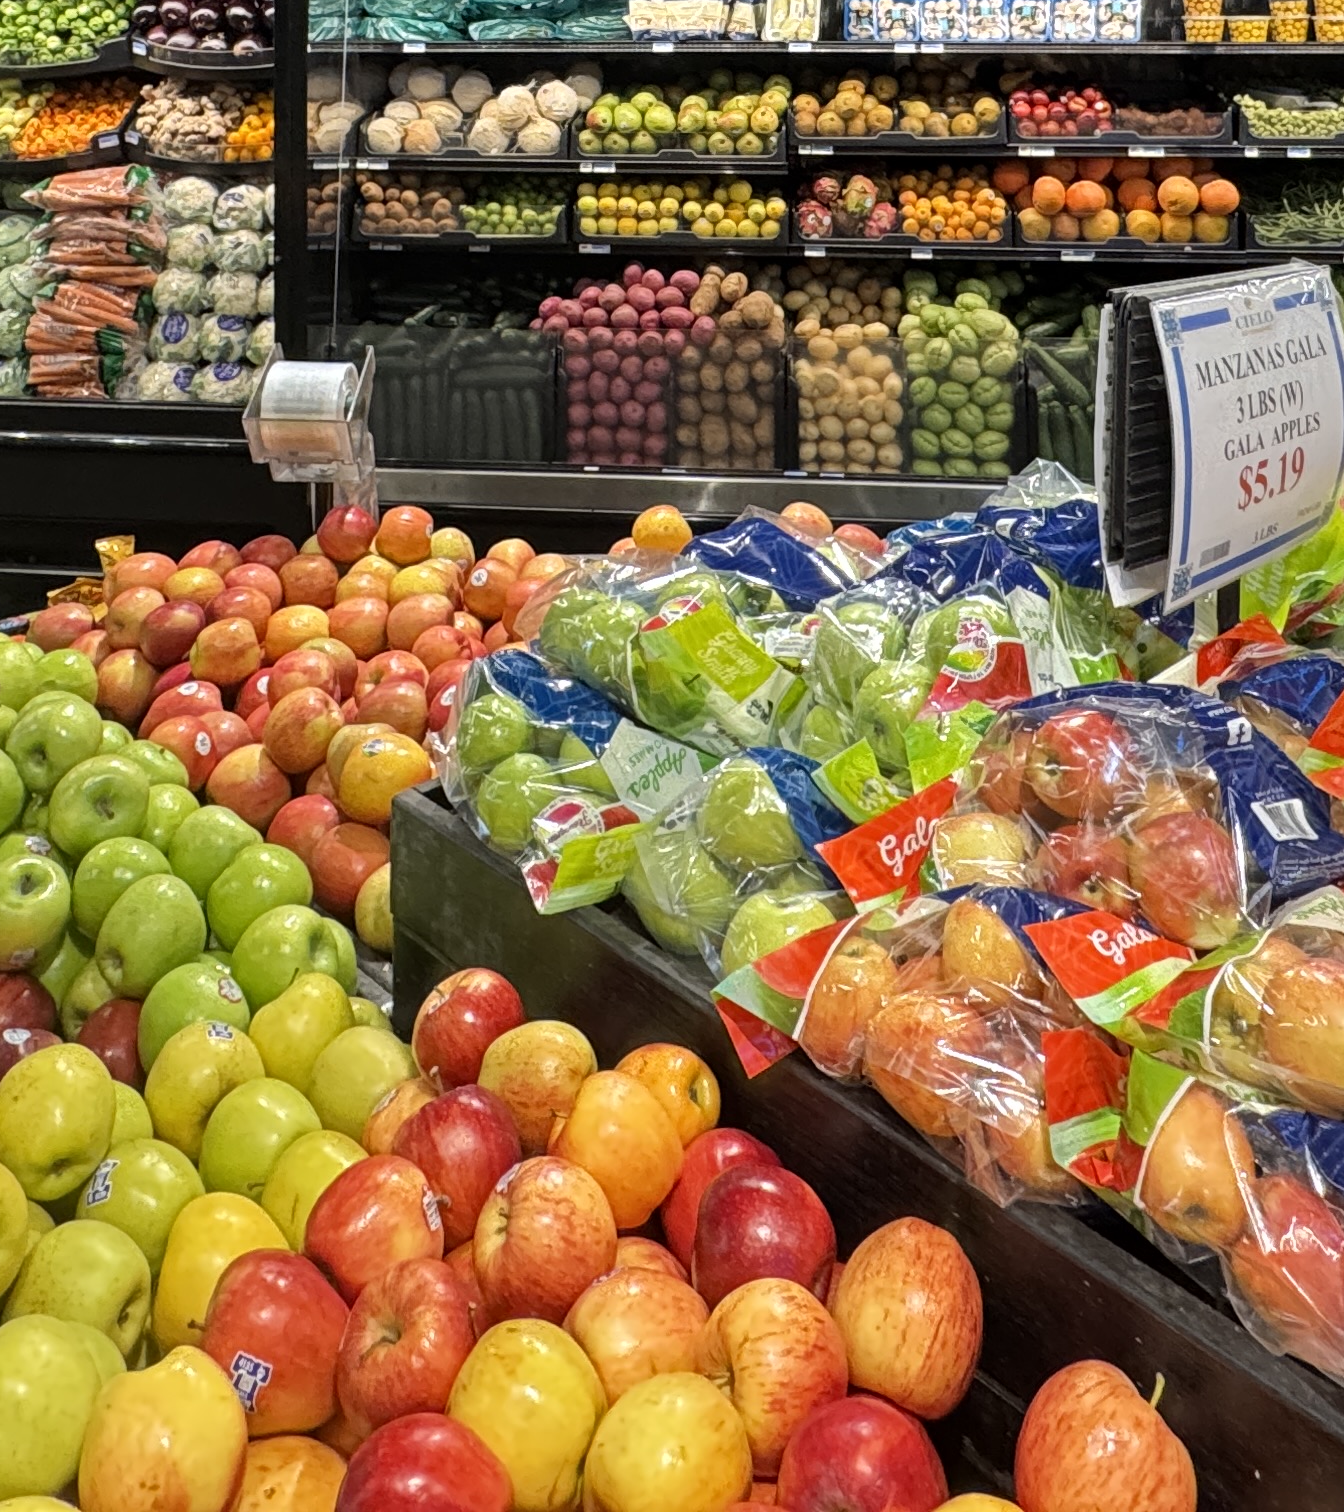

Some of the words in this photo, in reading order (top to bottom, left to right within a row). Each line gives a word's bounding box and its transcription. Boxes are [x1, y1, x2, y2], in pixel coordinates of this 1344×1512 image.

[1235, 309, 1274, 331] CIELO
[1195, 341, 1285, 391] MANZANAS
[1286, 332, 1328, 365] GALA
[1236, 396, 1245, 424] 3
[1248, 388, 1277, 419] LBS
[1279, 381, 1305, 417] (W)
[1224, 430, 1265, 462] GALA
[1271, 412, 1321, 445] APPLES
[1237, 446, 1305, 512] $5.19
[625, 746, 687, 799] Apples
